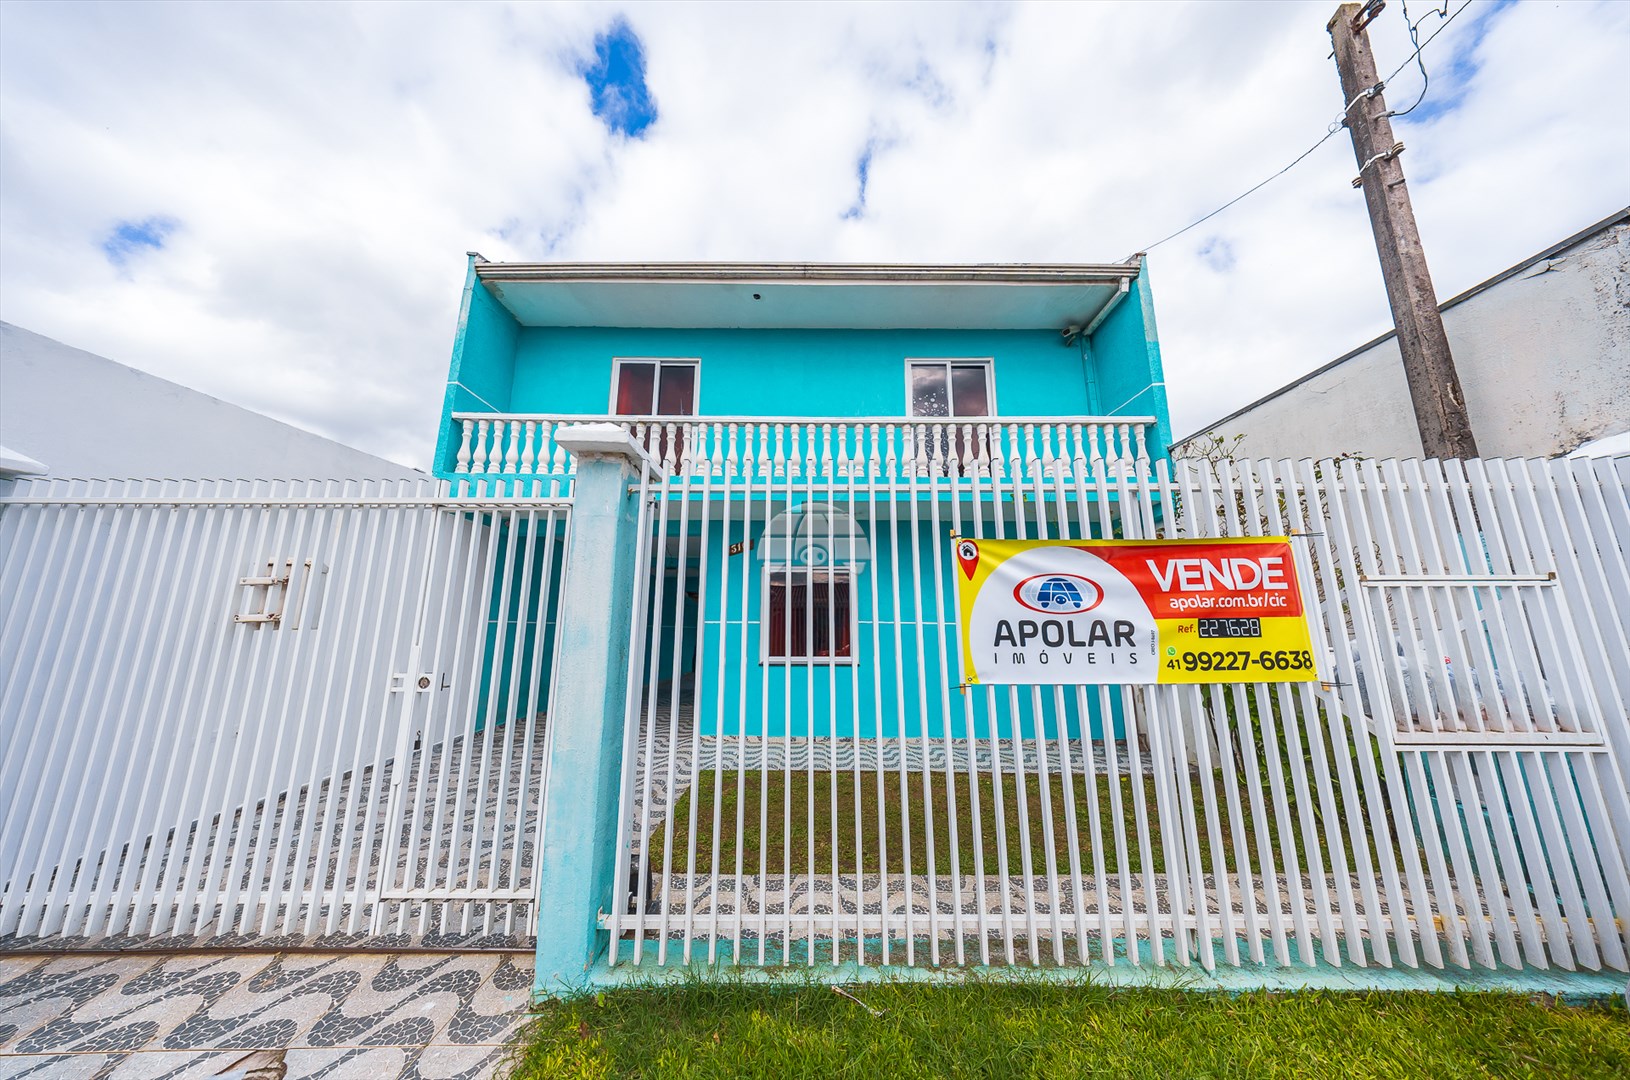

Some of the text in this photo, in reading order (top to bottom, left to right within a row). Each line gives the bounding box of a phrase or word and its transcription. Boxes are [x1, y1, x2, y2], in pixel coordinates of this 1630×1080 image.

[1145, 556, 1289, 592] VENDE
[1169, 592, 1288, 612] apolar.com.br/cic
[993, 619, 1137, 648] APOLAR
[1177, 623, 1197, 634] Ref.
[1199, 618, 1261, 637] 227628
[994, 649, 1138, 665] IMÓVEIS
[1166, 650, 1314, 672] 41 99227-6638
